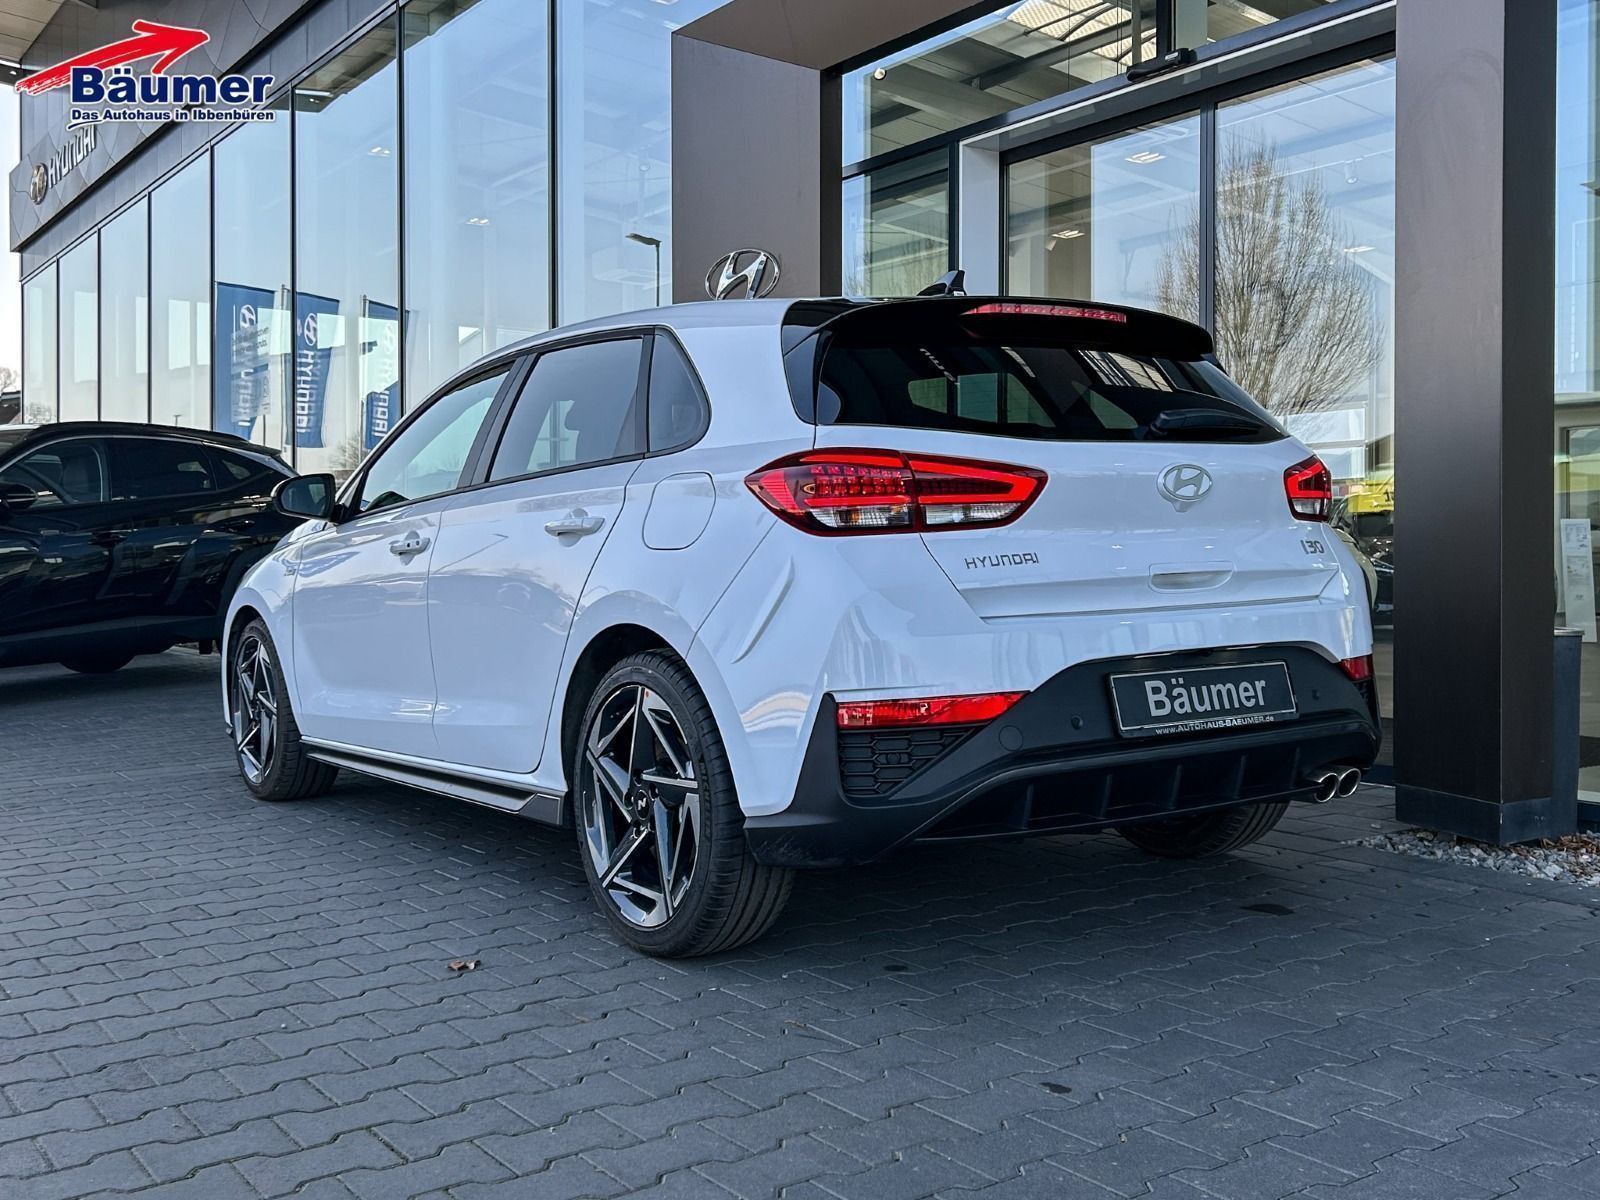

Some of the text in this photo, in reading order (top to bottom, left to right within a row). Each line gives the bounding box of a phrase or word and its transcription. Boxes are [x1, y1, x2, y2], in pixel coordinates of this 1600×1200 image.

[48, 123, 97, 189] HYUNDAI
[964, 552, 1039, 569] HYUNDAI
[1144, 677, 1266, 717] Bäumer
[1155, 715, 1274, 735] www.AUTOHAUS-BAEUMER.de
[637, 797, 647, 810] N
